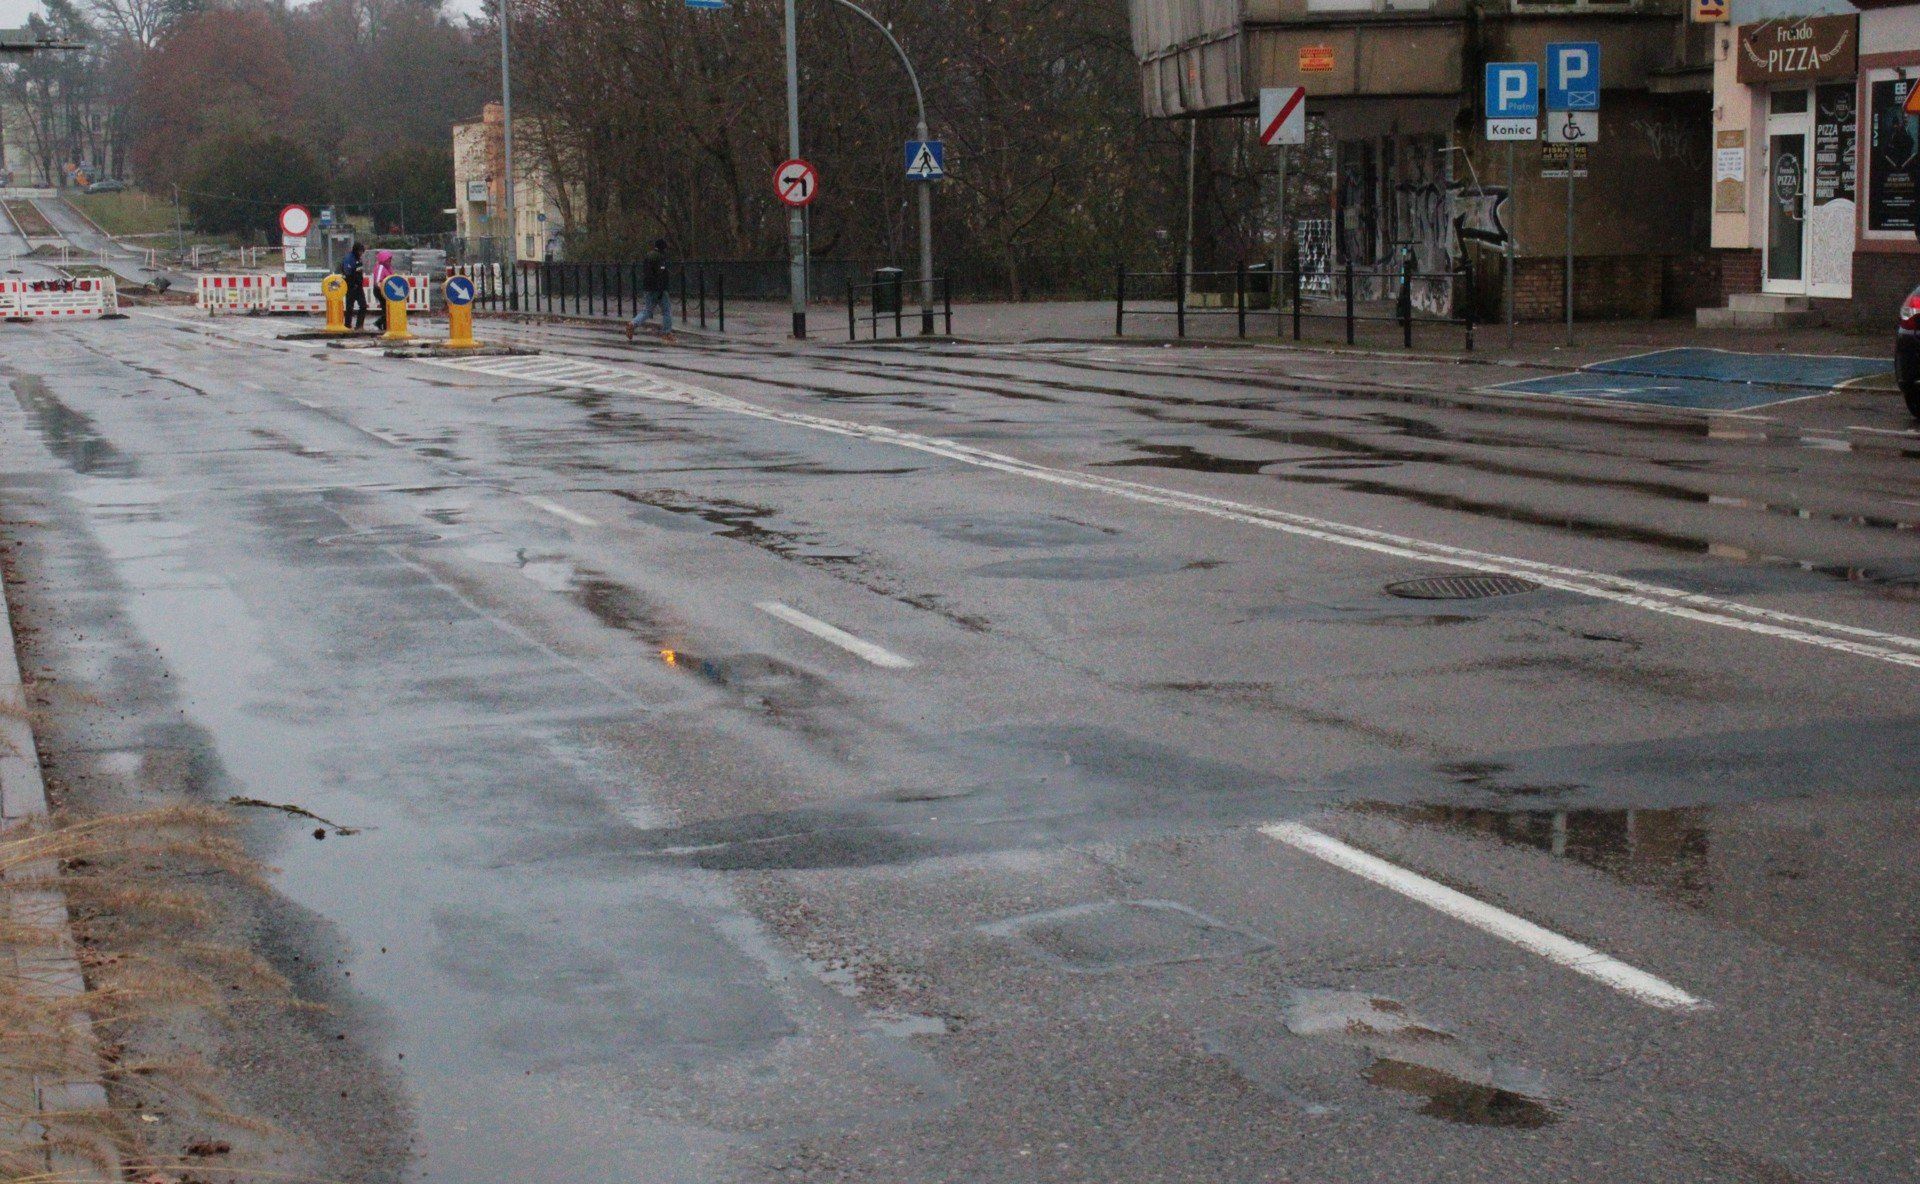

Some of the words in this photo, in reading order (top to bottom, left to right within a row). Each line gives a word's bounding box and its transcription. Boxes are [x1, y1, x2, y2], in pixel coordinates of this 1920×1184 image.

[1768, 46, 1820, 72] PIZZA
[1559, 49, 1588, 90] P
[1499, 70, 1527, 110] P
[1492, 125, 1531, 135] Koniec
[1817, 124, 1838, 135] PIZZA
[1777, 175, 1797, 186] PIZZA
